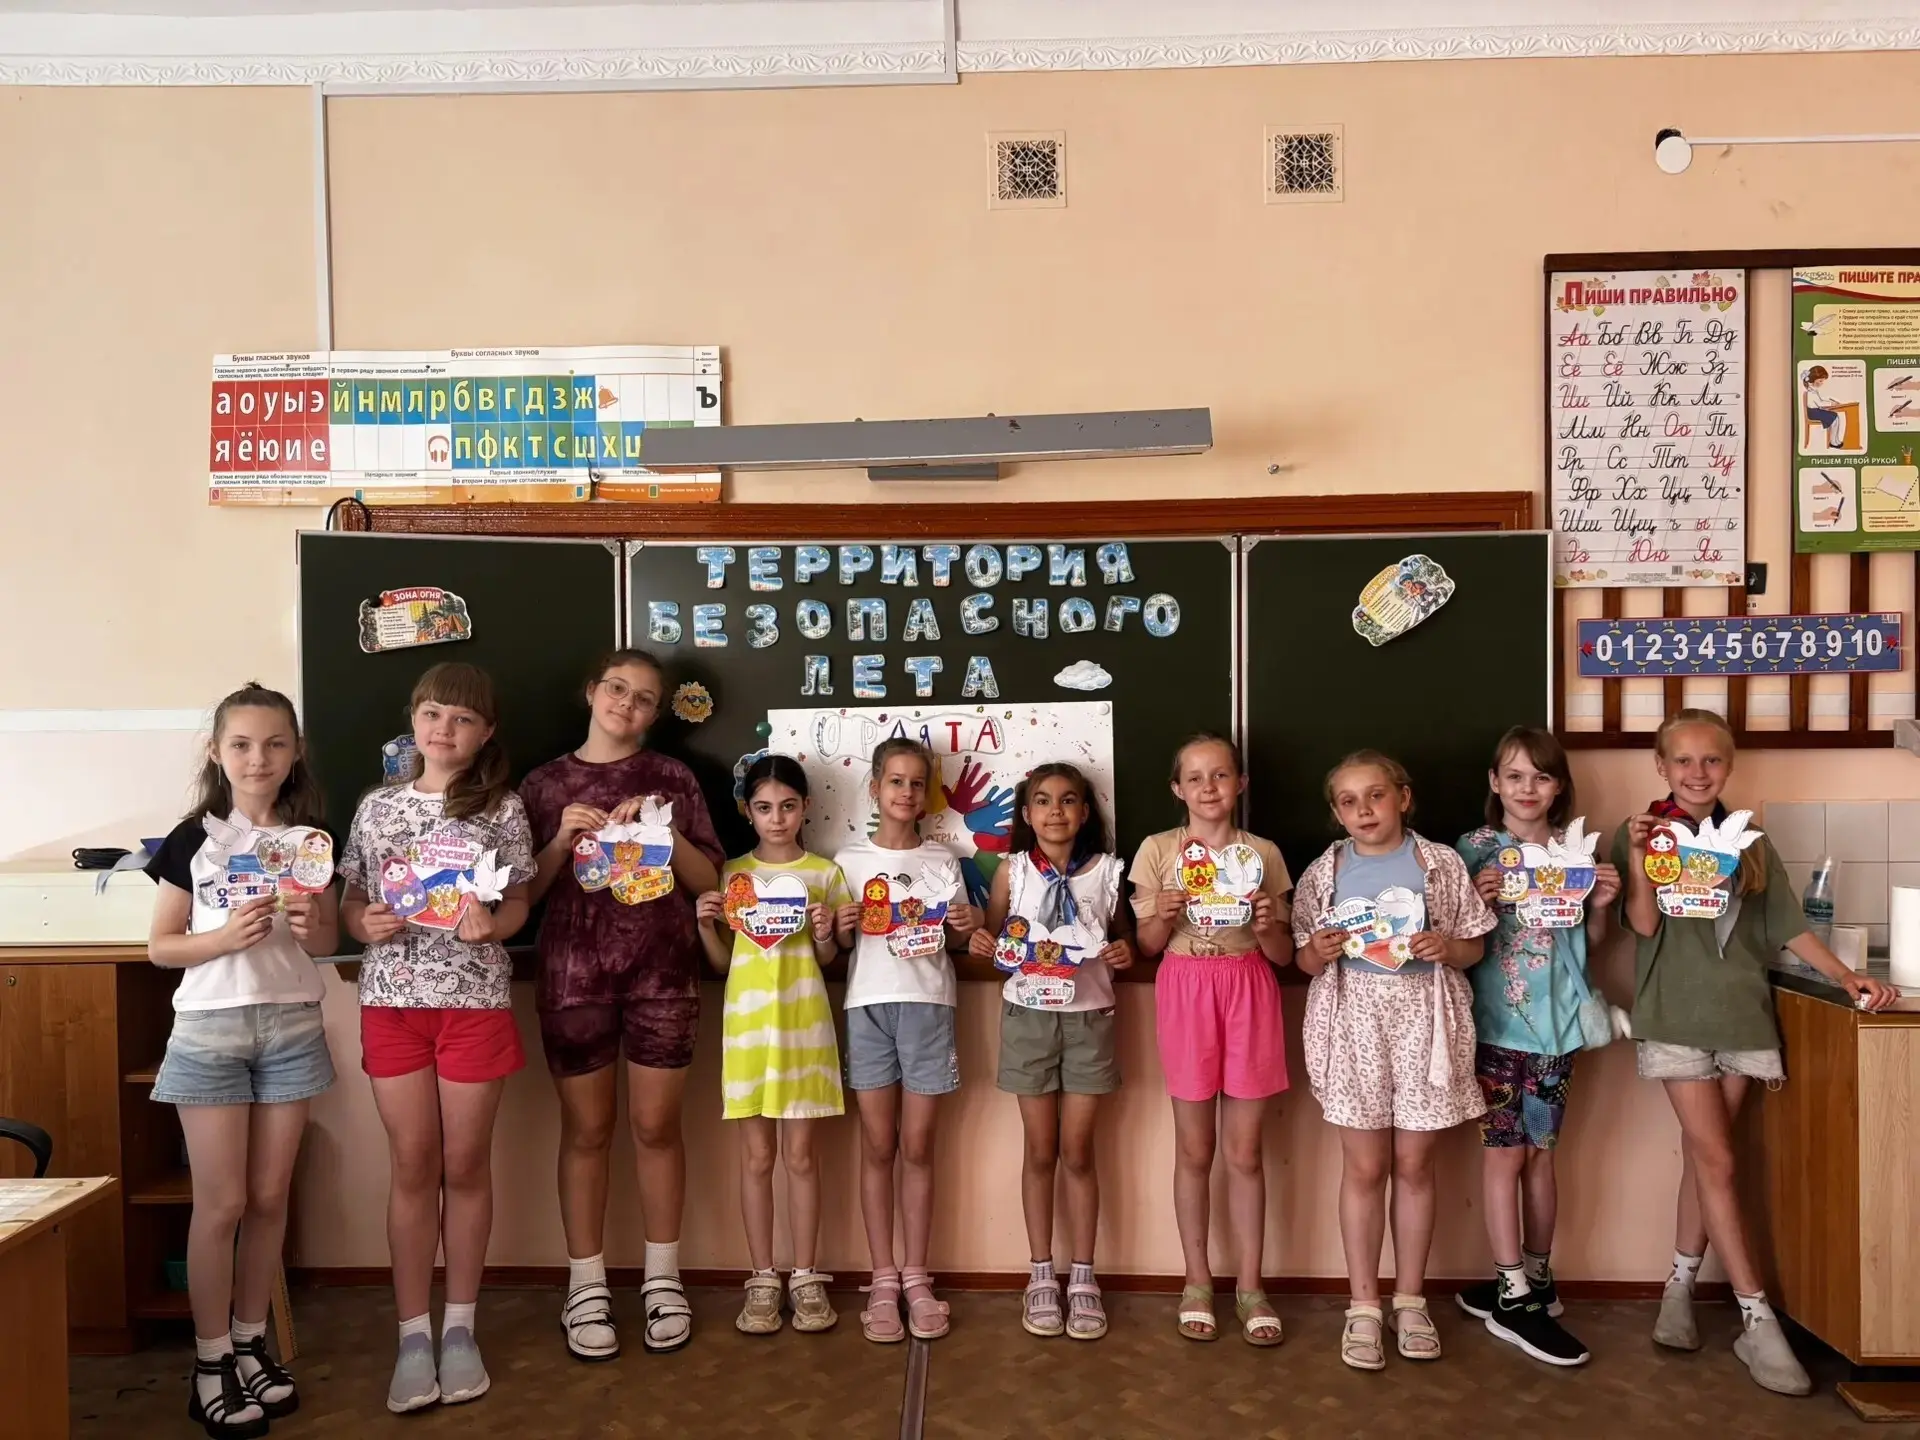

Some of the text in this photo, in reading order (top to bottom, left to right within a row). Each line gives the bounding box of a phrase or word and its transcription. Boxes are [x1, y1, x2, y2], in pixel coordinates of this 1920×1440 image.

[1838, 271, 1895, 283] ПИШИТЕ
[1558, 319, 1737, 351] Аа Бб Вв Гг Дд
[232, 354, 254, 363] Буквы
[286, 354, 310, 362] звуков
[450, 349, 474, 358] Буквы
[514, 348, 540, 357] звуков
[1560, 350, 1729, 384] Ее Ёё Жж Зз
[215, 392, 231, 414] а
[239, 392, 255, 414] о
[263, 391, 279, 421] у
[284, 391, 303, 413] ы
[310, 390, 325, 413] э
[333, 382, 349, 412] й
[358, 390, 373, 412] н
[380, 390, 401, 412] м
[407, 390, 423, 412] л
[430, 390, 445, 420] р
[453, 380, 471, 412] б
[478, 387, 495, 411] в
[504, 387, 516, 410] г
[525, 388, 544, 415] д
[552, 387, 567, 410] з
[574, 387, 593, 409] ж
[1559, 381, 1722, 408] Ии Йй Кк Лл
[1559, 412, 1736, 439] Мм Нн Оо Пп
[215, 429, 618, 467] я ё ю и е п ф к т с ш х
[1558, 443, 1736, 478] Рр Сс Тт Уу
[1843, 457, 1870, 465] ЛЕВОЙ
[1871, 457, 1897, 465] РУКОЙ
[1568, 475, 1729, 509] Фф Хх Цц Чч
[1559, 508, 1737, 537] Шш Щщ ъ ы ь
[1565, 537, 1722, 563] Ээ Юю Яя
[696, 542, 1136, 591] ТЕРРИТОРИЯ
[393, 590, 441, 601] ЗОНА ОГНЯ
[647, 592, 1182, 649] БЕЗОПАСНОГО
[1596, 628, 1883, 662] 0 1 2 3 4 5 6 7 8 9 10
[799, 653, 1000, 698] ЛЕТА
[934, 813, 945, 830] 2
[428, 832, 468, 849] День
[418, 843, 476, 862] России
[421, 856, 469, 870] 12 июня
[1672, 883, 1710, 896] День
[1669, 905, 1685, 916] 12
[749, 915, 799, 925] России
[1198, 916, 1213, 926] 12
[1528, 917, 1543, 927] 12
[754, 924, 795, 935] 12 июня
[897, 947, 911, 958] 12
[1024, 996, 1038, 1006] 12
